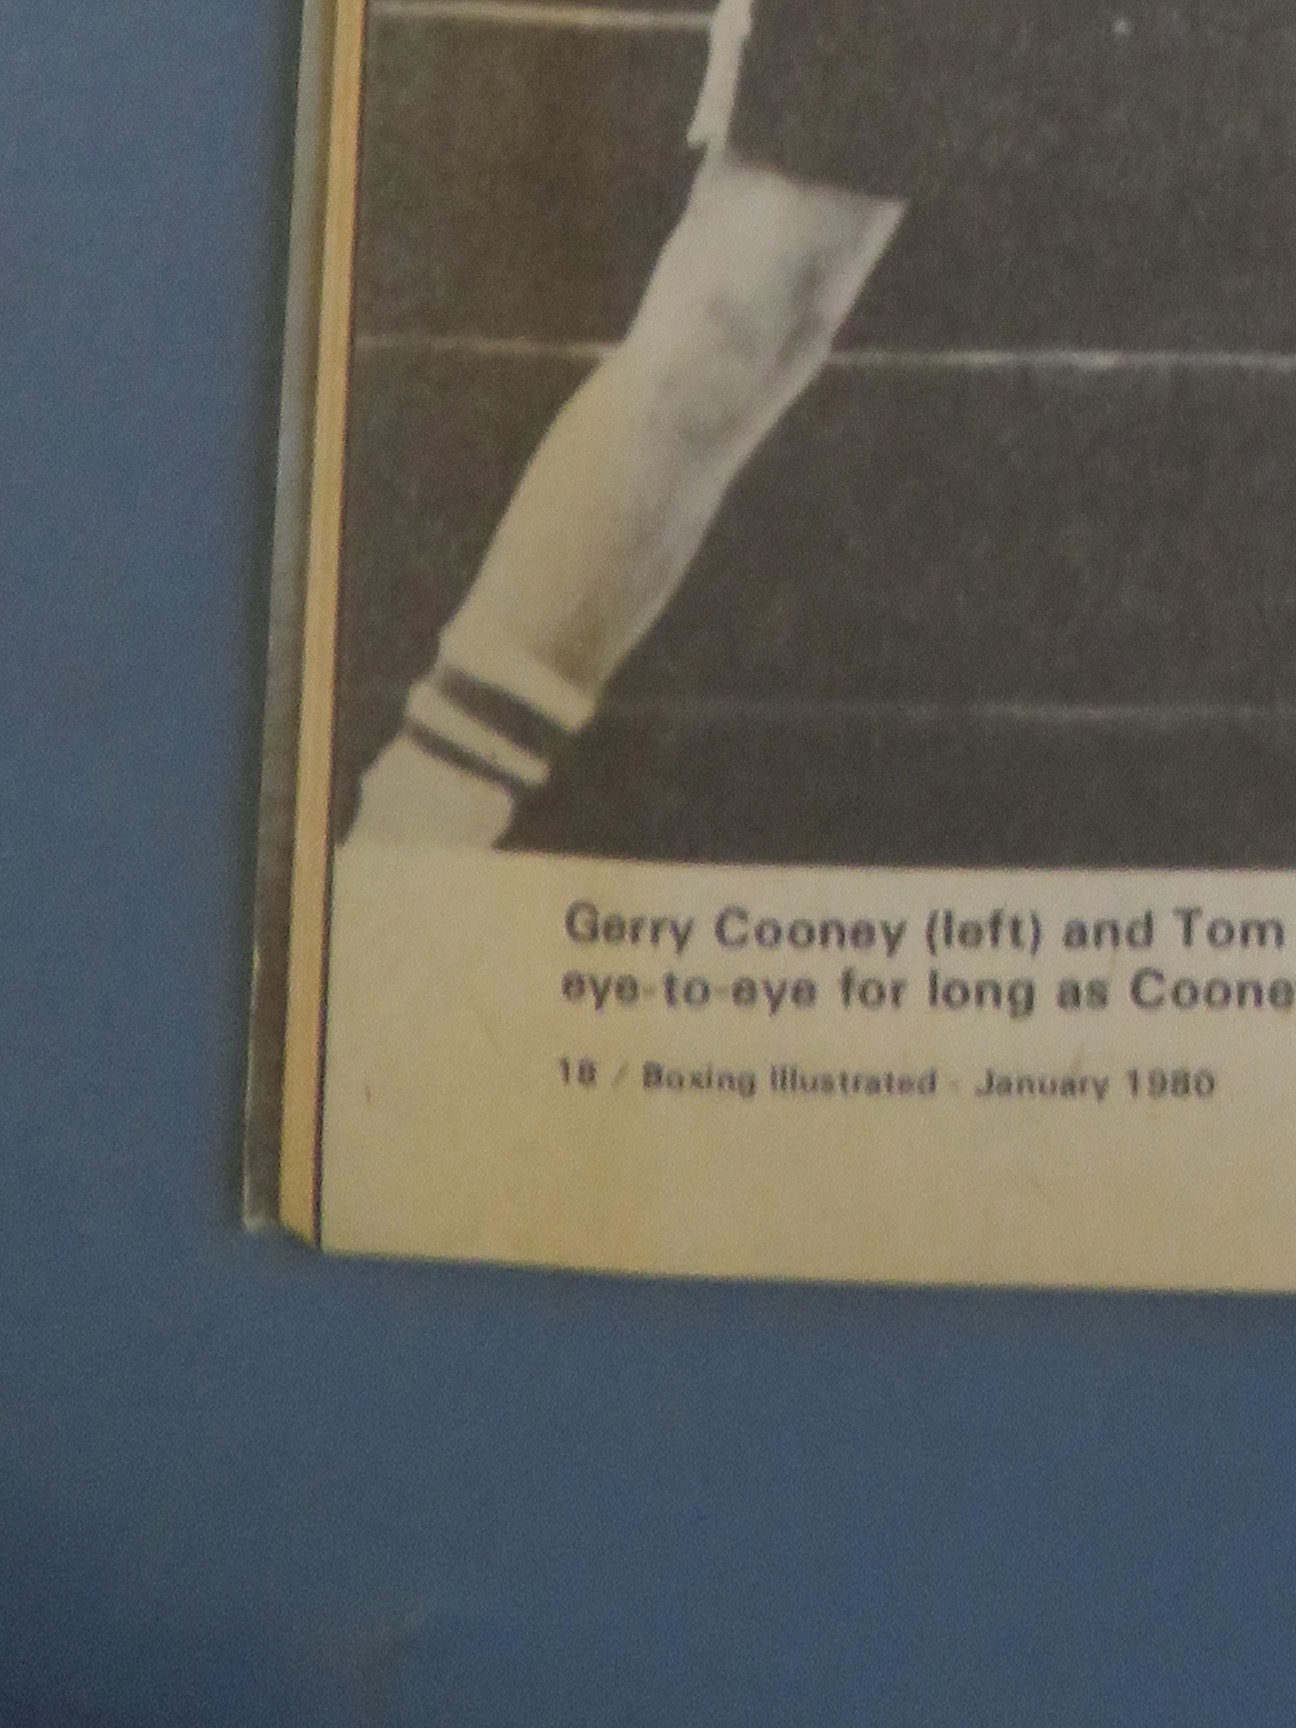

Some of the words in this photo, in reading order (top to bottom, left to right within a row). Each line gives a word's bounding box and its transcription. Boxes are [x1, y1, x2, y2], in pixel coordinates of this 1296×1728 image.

[563, 899, 696, 958] Gerry
[712, 904, 909, 960] Cooney
[923, 906, 1045, 959] (left)
[1060, 907, 1157, 952] and
[1171, 905, 1287, 951] Tom
[837, 964, 909, 1011] for
[926, 966, 1038, 1022] long
[1054, 976, 1111, 1013] as
[639, 1058, 760, 1102] Boxing
[767, 1062, 940, 1099] Illustrated
[972, 1064, 1114, 1106] January
[1124, 1065, 1220, 1103] 1980
